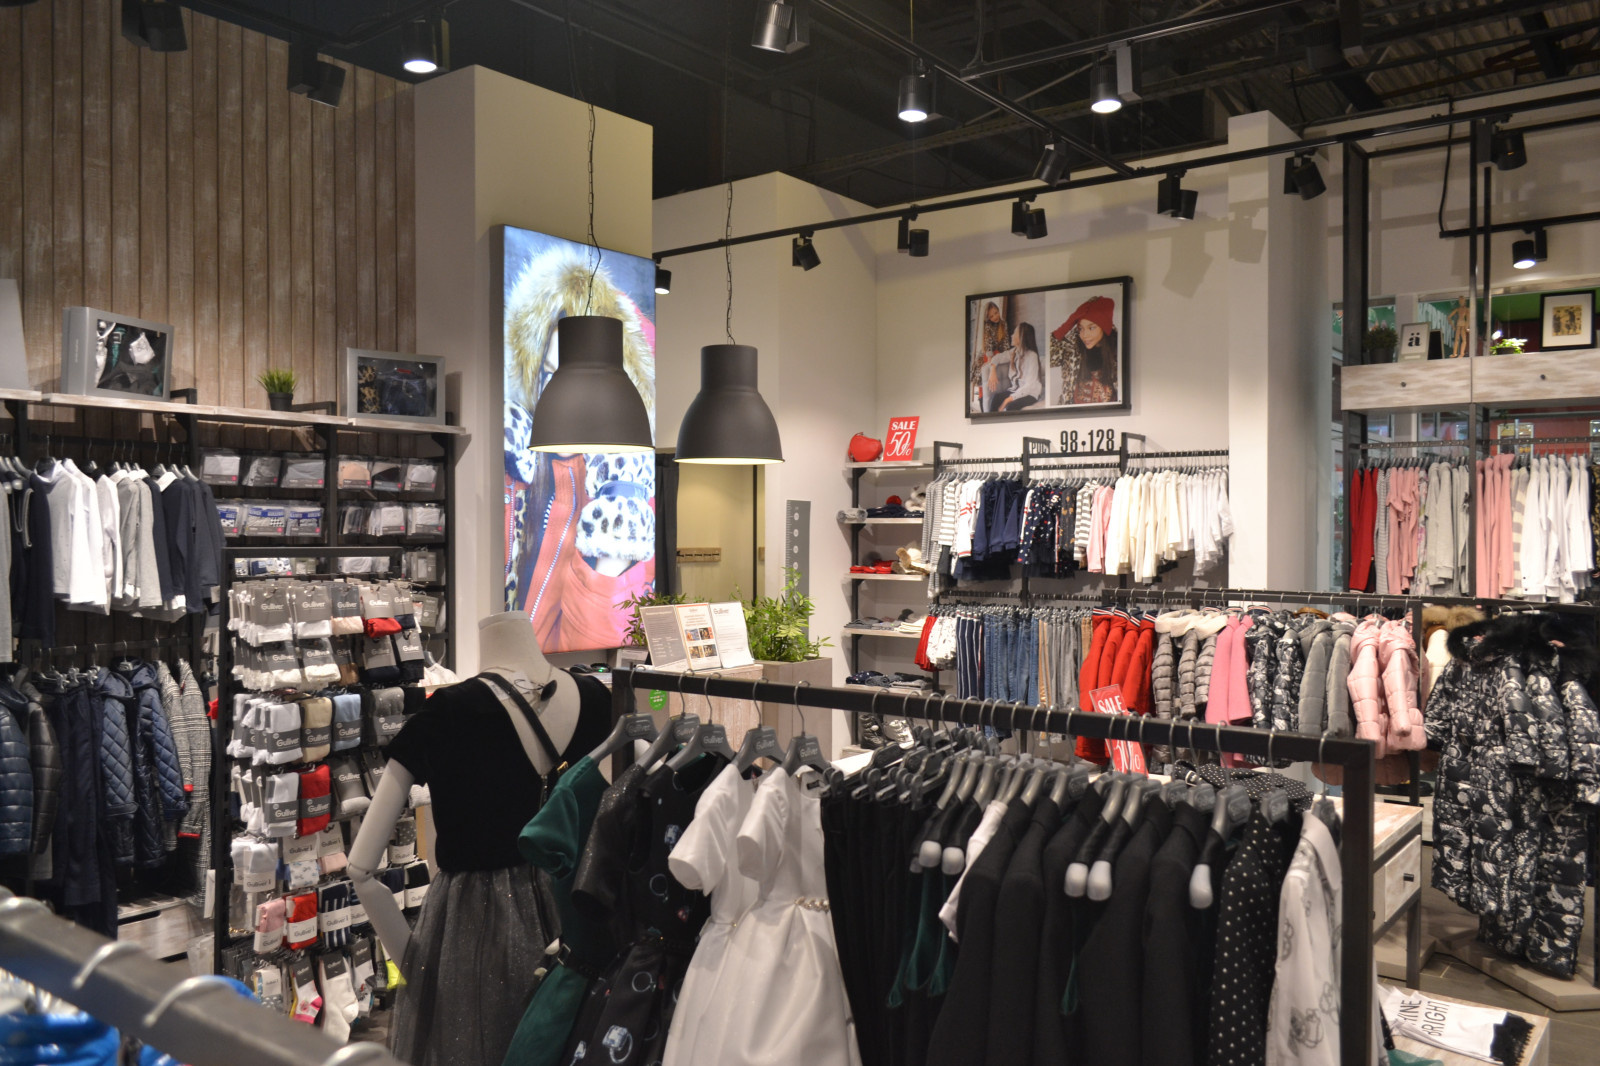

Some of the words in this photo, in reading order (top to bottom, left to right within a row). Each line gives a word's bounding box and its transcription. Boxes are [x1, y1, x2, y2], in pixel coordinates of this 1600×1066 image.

[1408, 332, 1420, 346] ä
[892, 420, 916, 430] SALE
[886, 431, 912, 456] 50%
[1098, 696, 1125, 714] SALE
[276, 738, 299, 747] Gulliver
[308, 734, 329, 742] Gulliver
[308, 803, 330, 812] Gulliver
